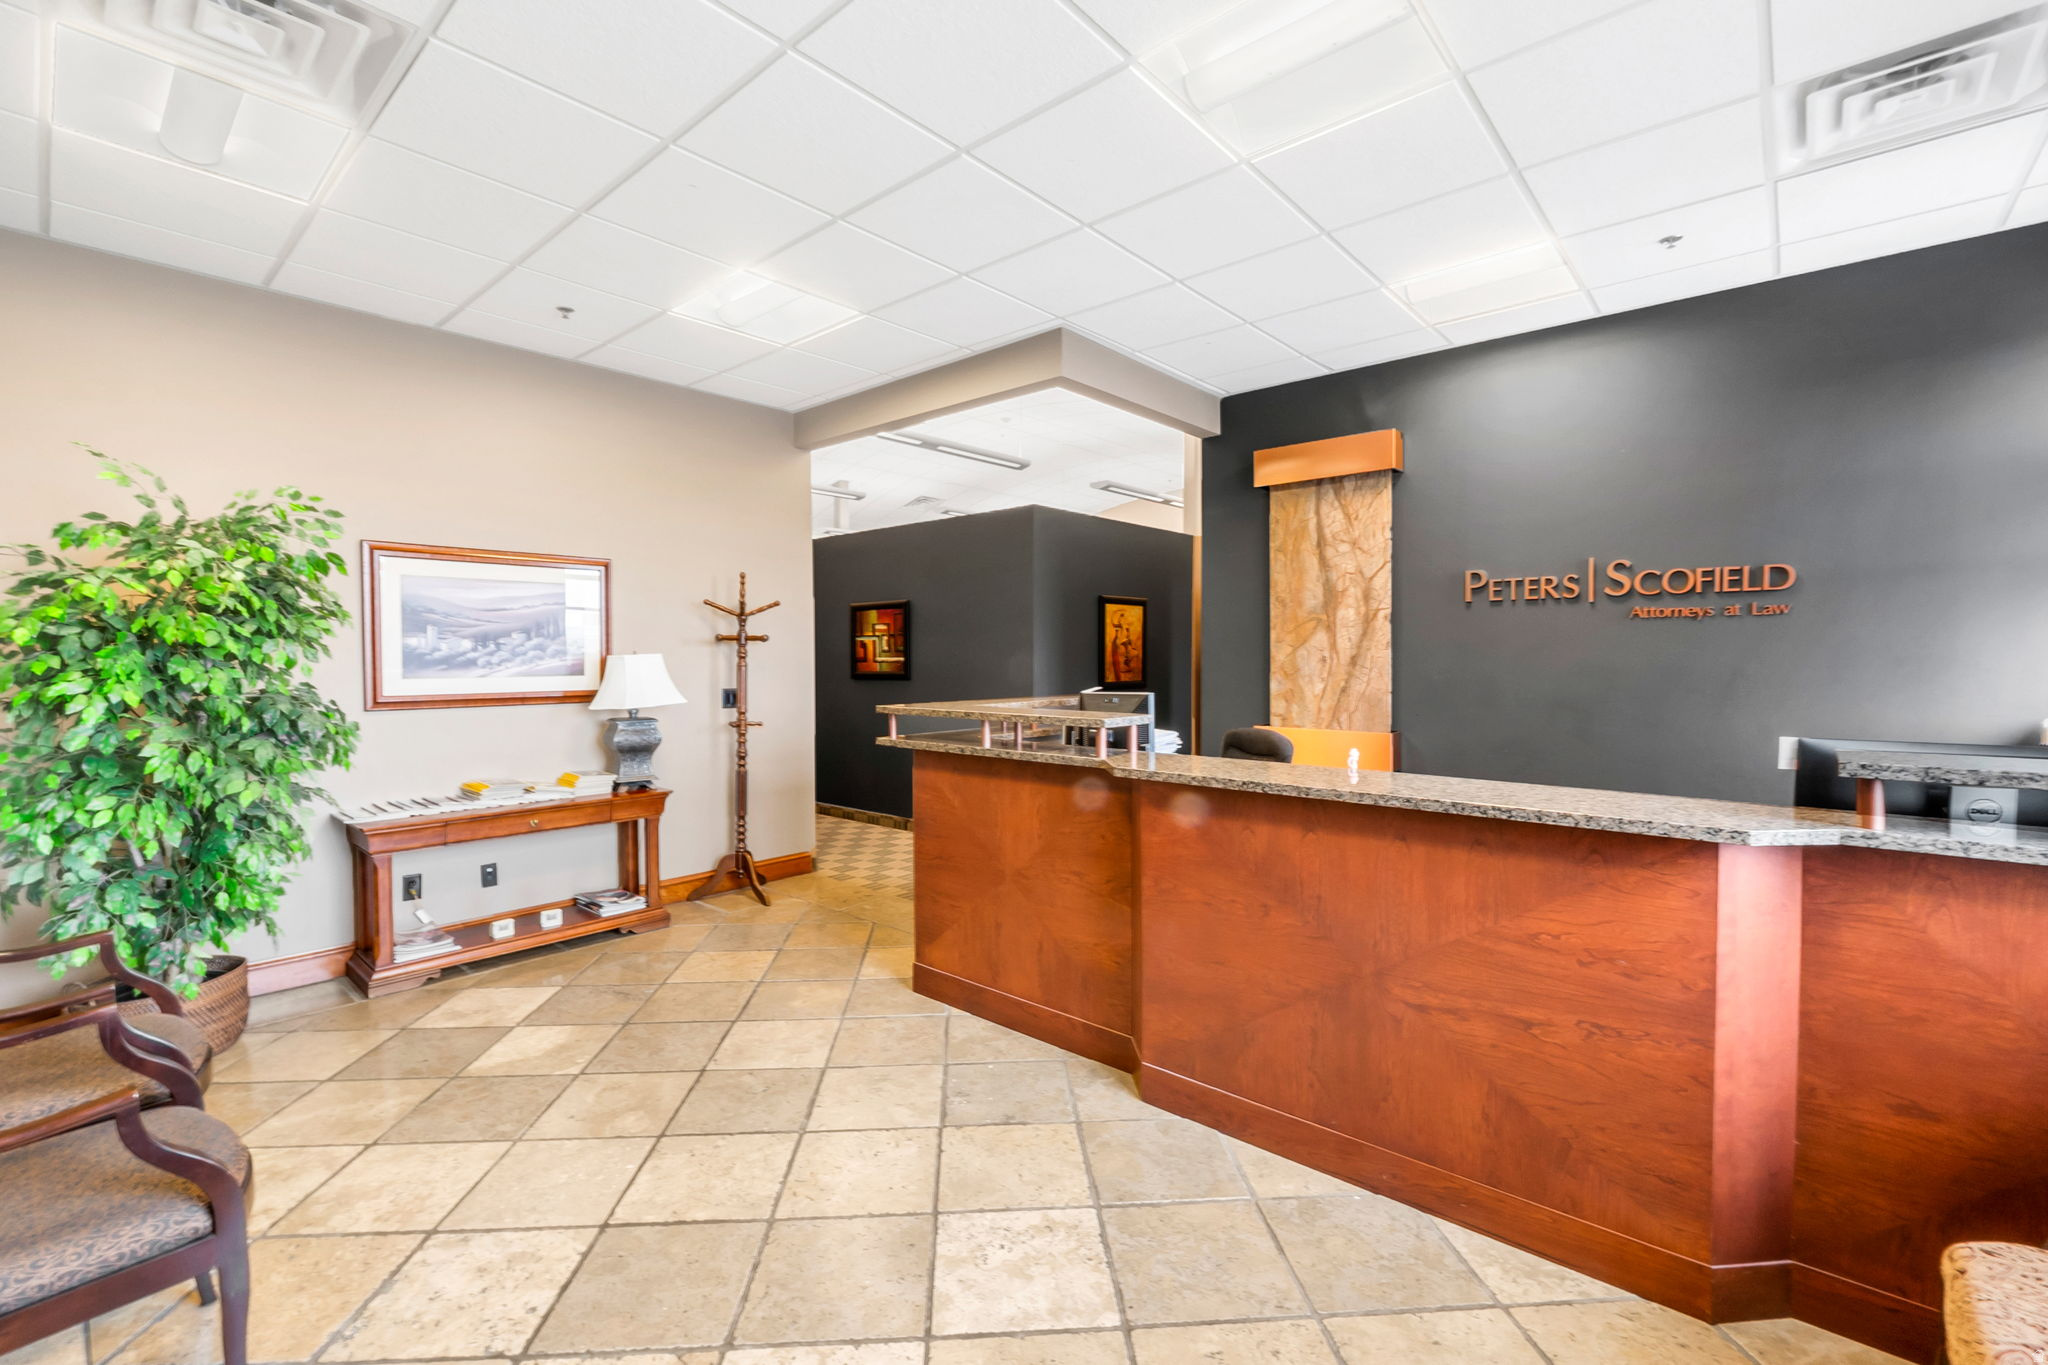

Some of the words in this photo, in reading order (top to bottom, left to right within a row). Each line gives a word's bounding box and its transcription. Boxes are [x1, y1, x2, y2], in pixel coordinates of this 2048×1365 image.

[1630, 605, 1715, 620] Attorneys
[1723, 603, 1742, 616] at
[1751, 601, 1792, 616] Law
